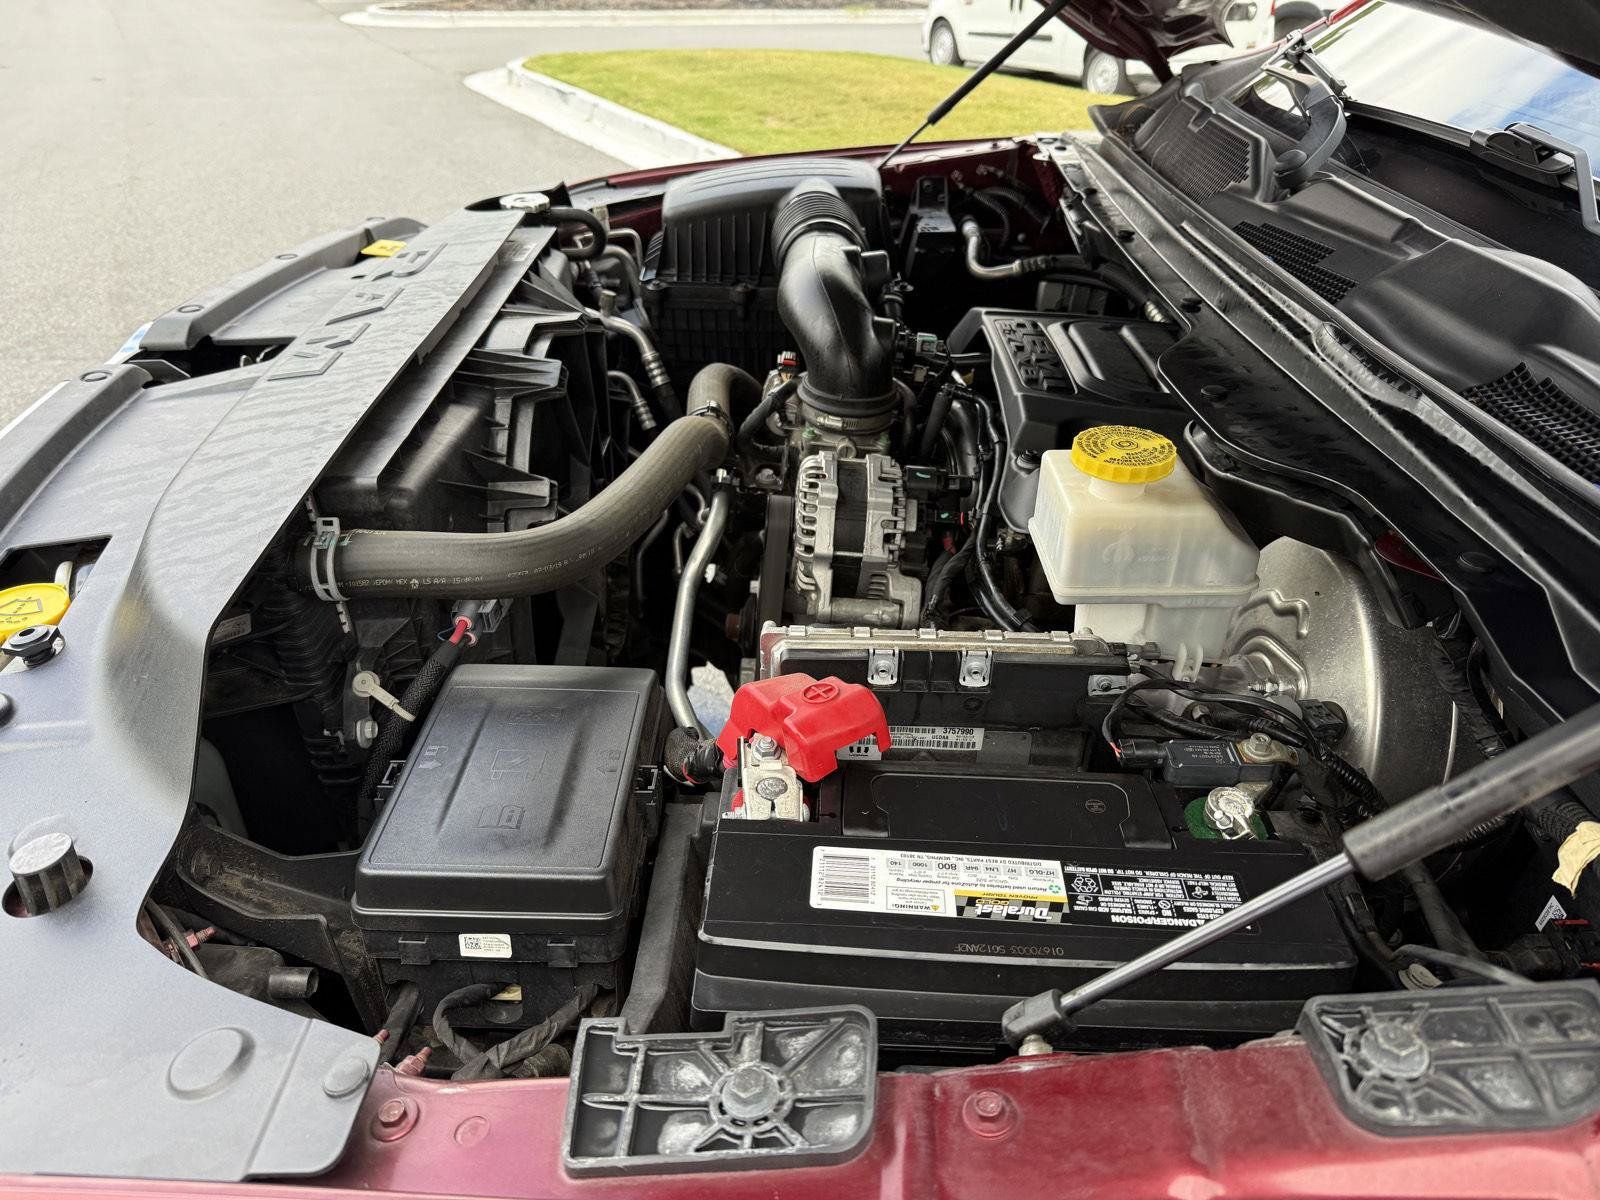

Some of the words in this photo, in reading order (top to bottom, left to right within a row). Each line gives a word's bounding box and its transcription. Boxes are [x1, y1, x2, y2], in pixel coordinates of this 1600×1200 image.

[1016, 319, 1068, 391] HEMI
[942, 727, 974, 735] 3757990
[937, 863, 957, 871] 800
[974, 904, 1052, 920] Duralast
[1111, 915, 1197, 927] DANGER/POISON
